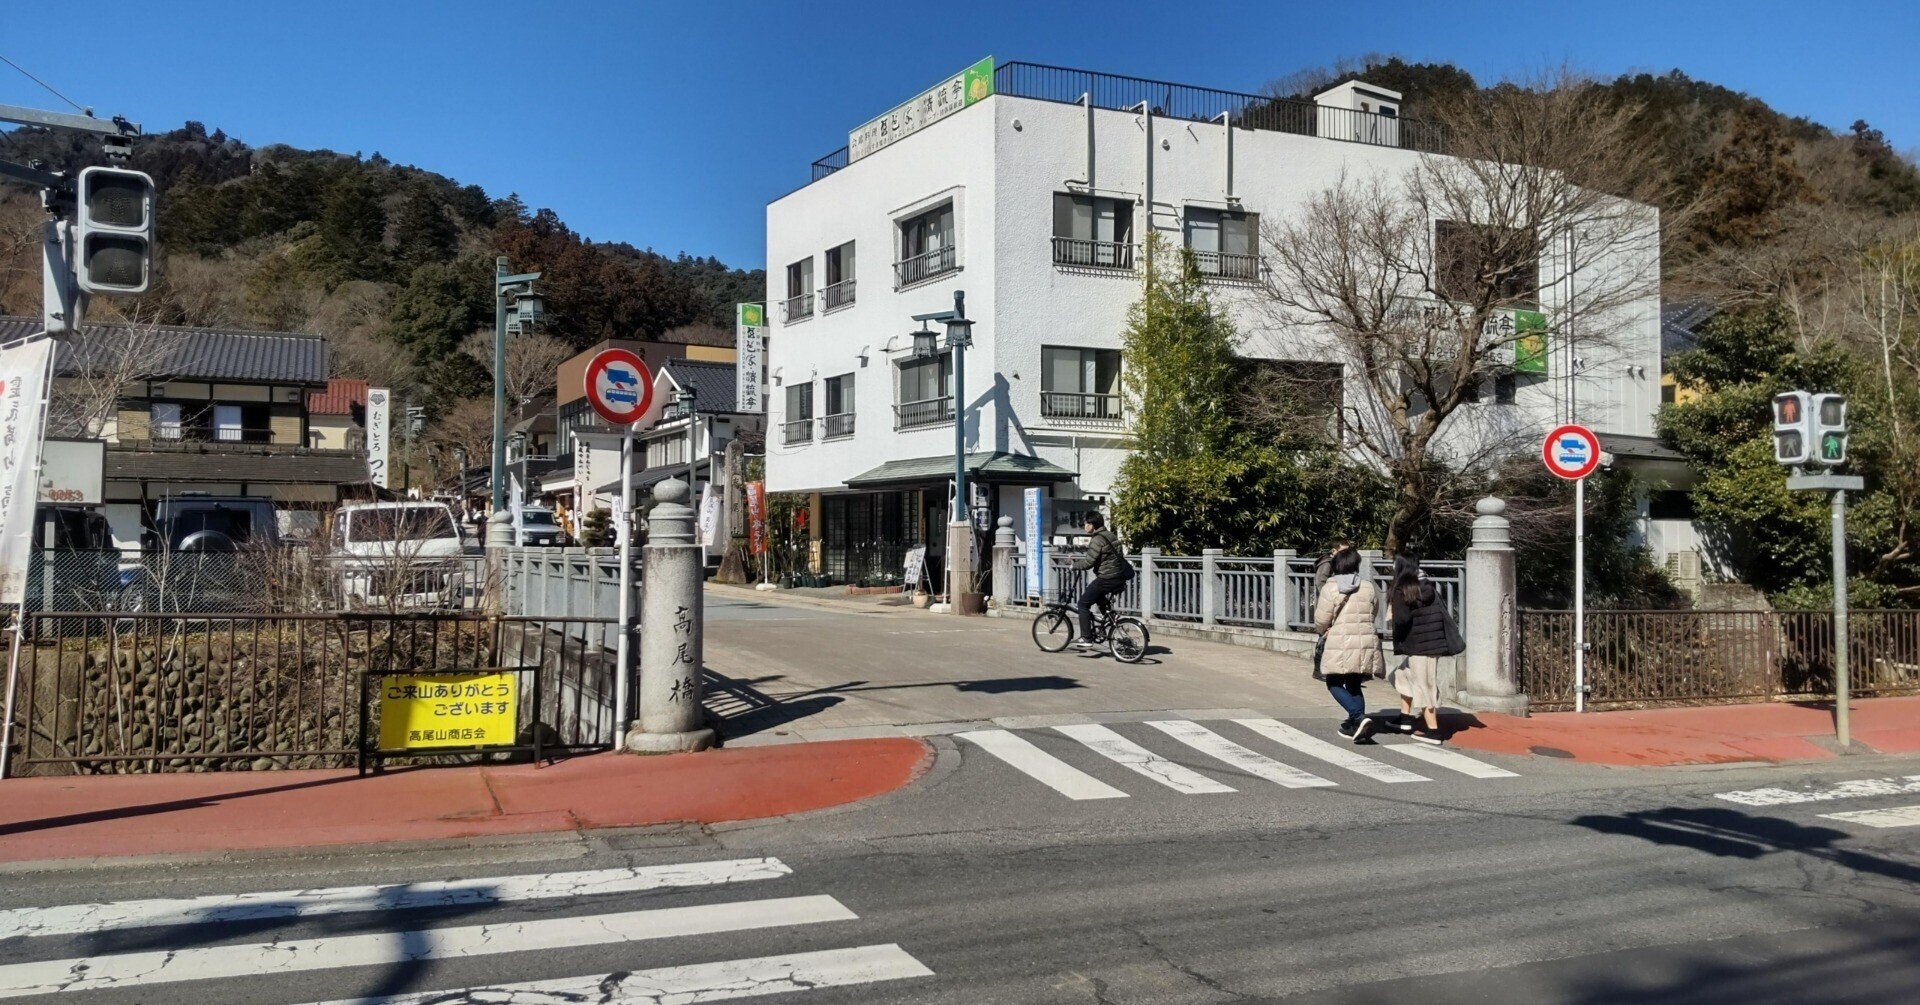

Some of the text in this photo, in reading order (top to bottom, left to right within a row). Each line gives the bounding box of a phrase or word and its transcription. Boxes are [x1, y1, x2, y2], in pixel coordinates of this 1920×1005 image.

[373, 411, 382, 452] むぎとろ
[669, 606, 695, 703] 高尾橋
[388, 683, 510, 699] ご来山ありがとう
[434, 701, 509, 716] ございます
[409, 728, 486, 742] 高尾山商店会
